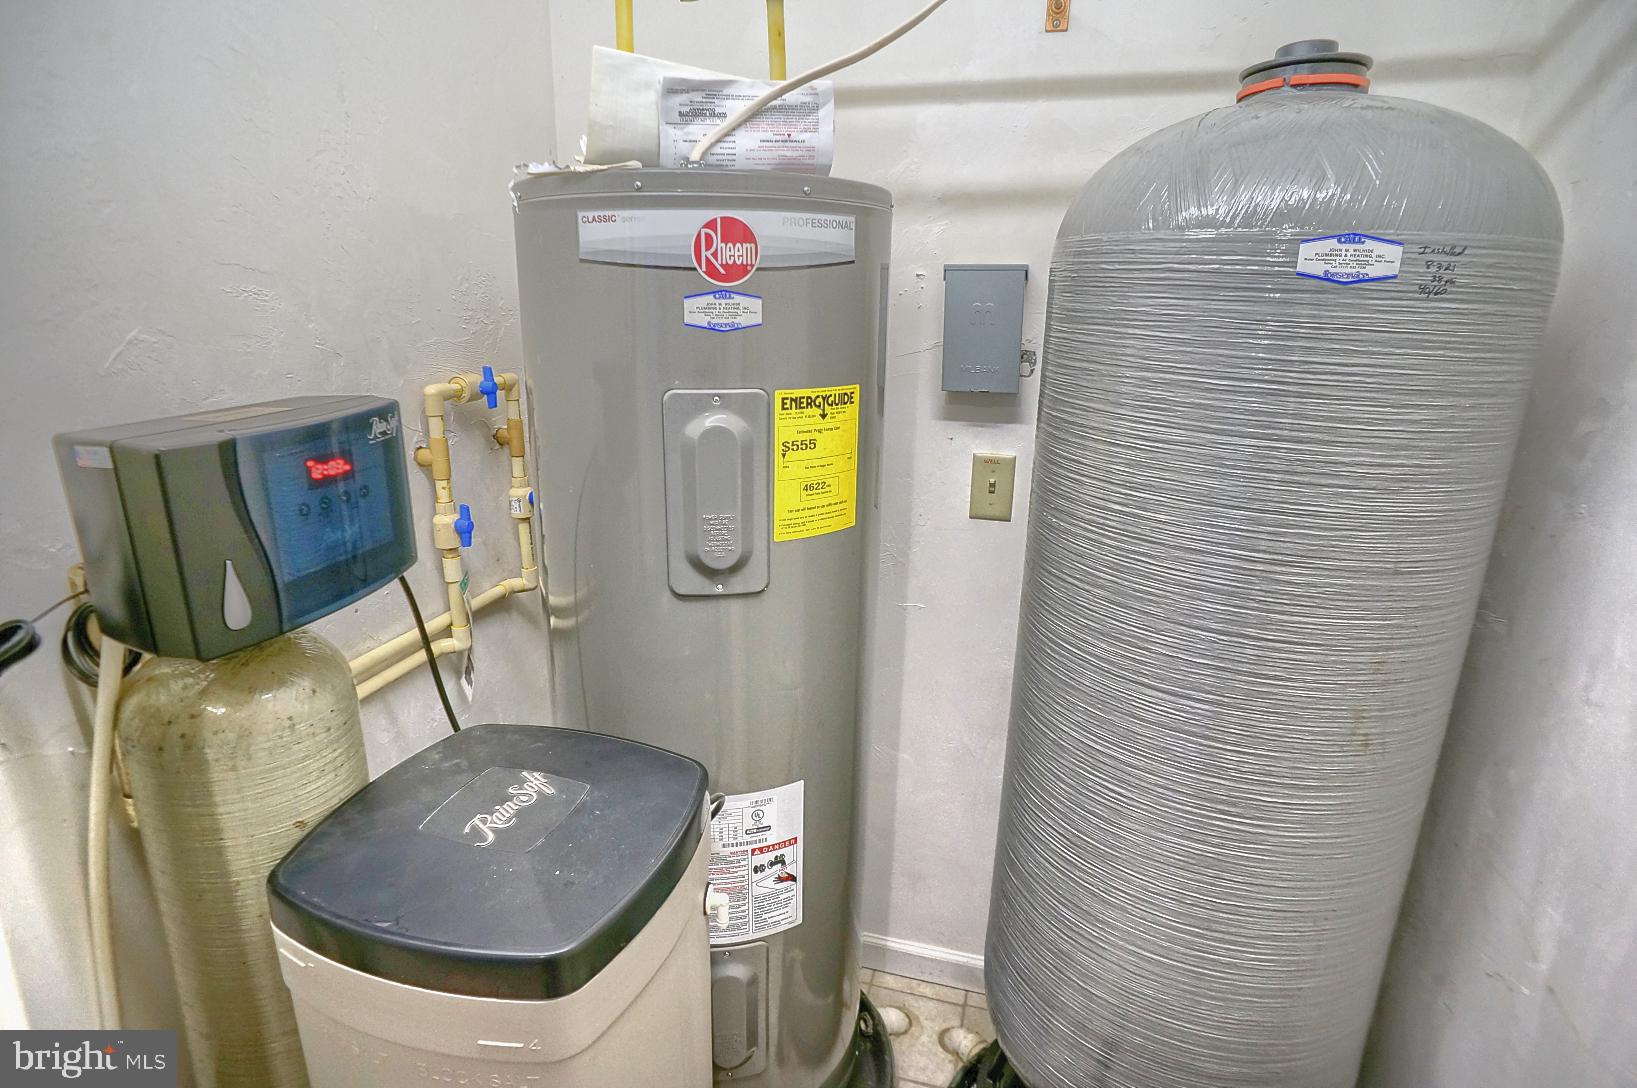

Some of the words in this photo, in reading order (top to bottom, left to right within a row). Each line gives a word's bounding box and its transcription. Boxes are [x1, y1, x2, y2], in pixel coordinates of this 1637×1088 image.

[581, 214, 617, 224] CLASSIC
[782, 216, 853, 231] PROFESSIONAL
[701, 217, 756, 275] Rheem
[781, 438, 818, 453] $555
[984, 457, 1001, 465] WELL
[803, 481, 826, 493] 4622
[464, 772, 555, 847] RainSoft
[762, 838, 795, 853] DANGER
